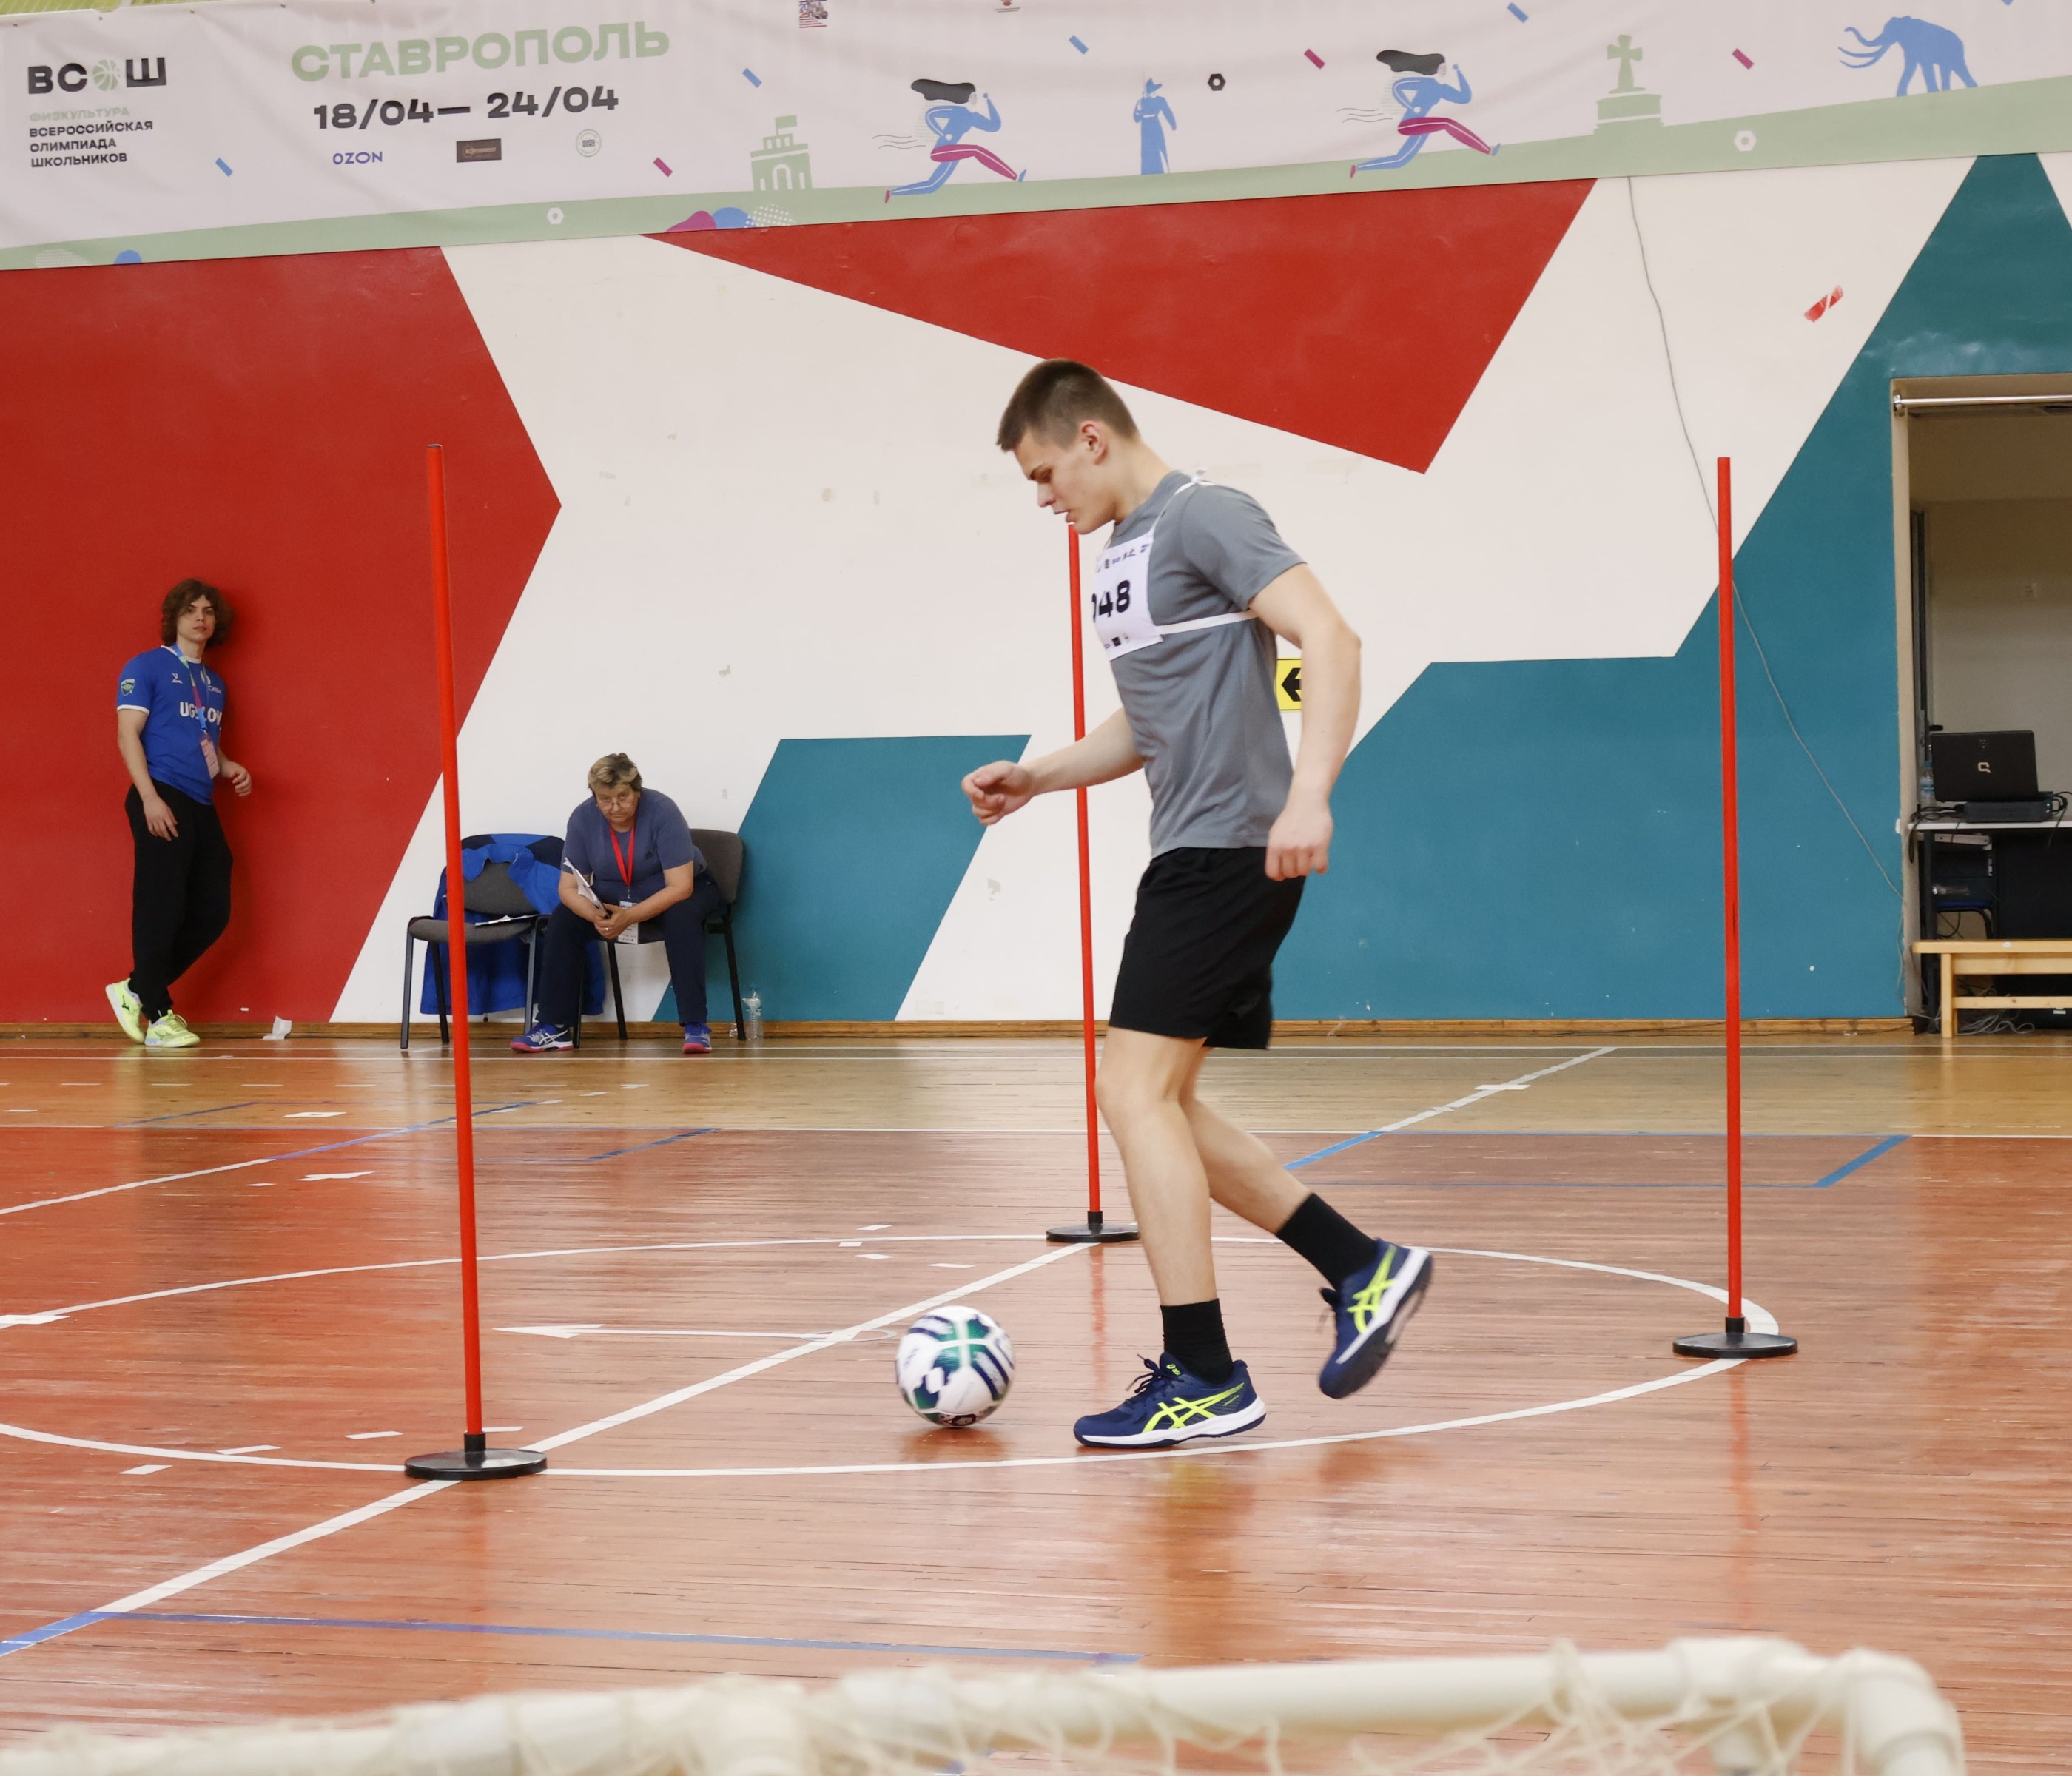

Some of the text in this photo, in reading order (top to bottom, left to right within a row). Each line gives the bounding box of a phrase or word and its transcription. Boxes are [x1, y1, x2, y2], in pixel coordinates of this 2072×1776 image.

[292, 21, 670, 82] СТАВРОПОЛЬ
[487, 86, 619, 118] 24/04
[29, 107, 130, 122] ФИЗКУЛЬТУРА
[30, 121, 153, 137] ВСЕРОССИЙСКАЯ
[30, 138, 116, 152] ОЛИМПИАДА
[31, 153, 127, 167] ШКОЛЬНИКОВ
[332, 151, 383, 165] OZON
